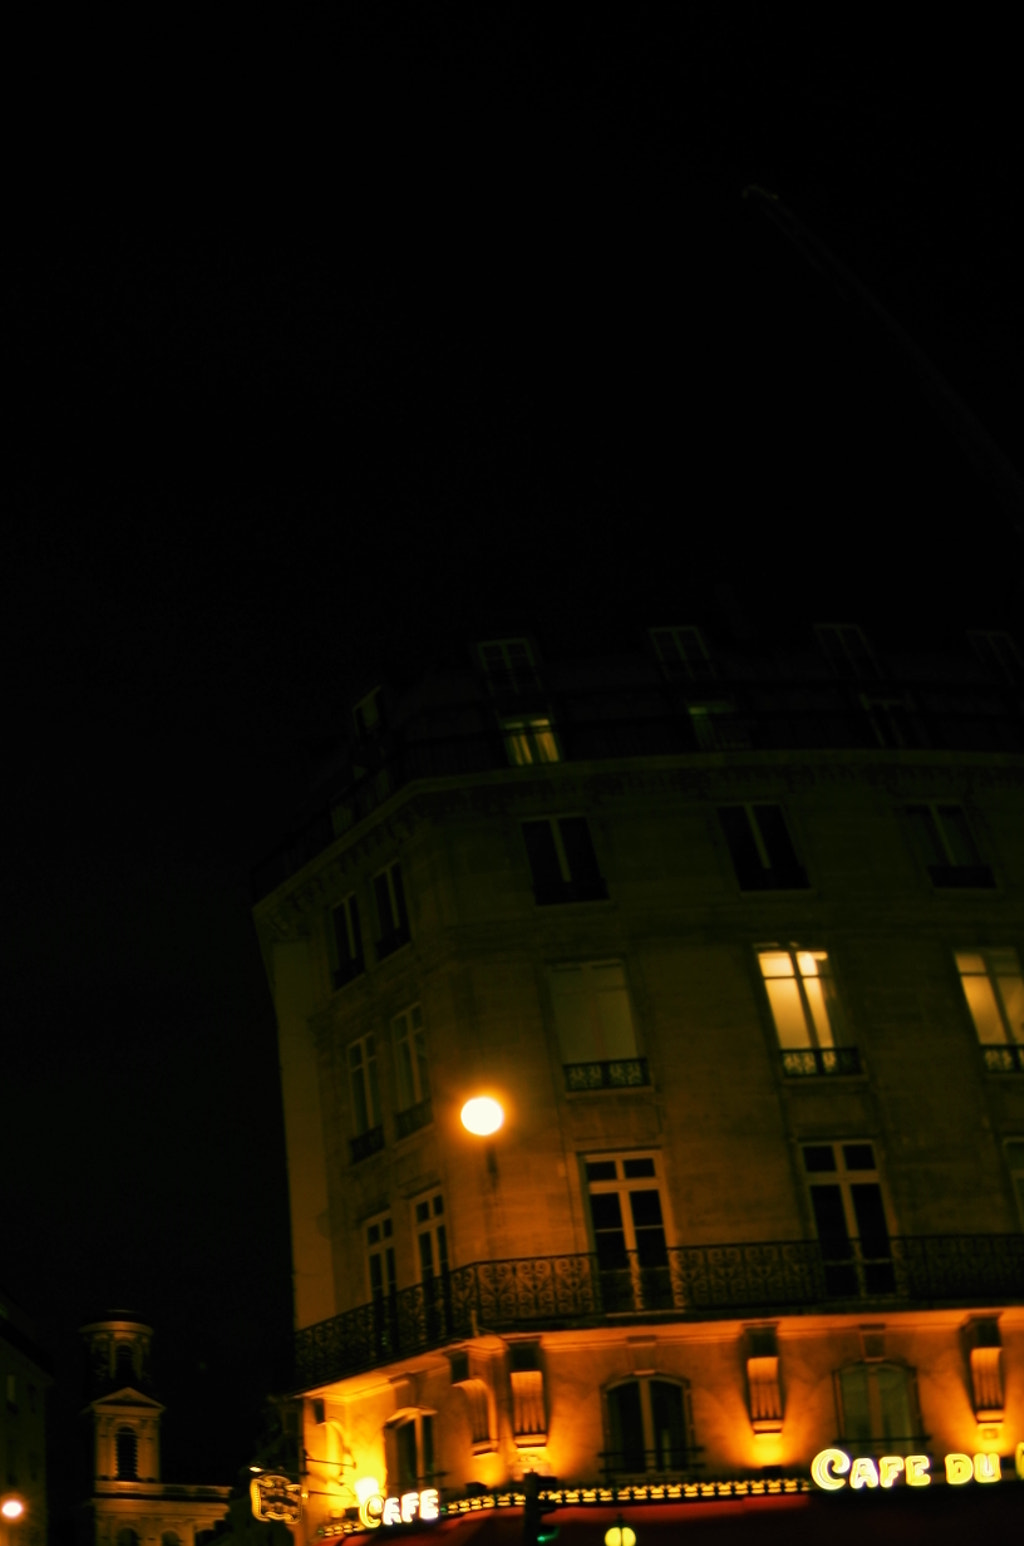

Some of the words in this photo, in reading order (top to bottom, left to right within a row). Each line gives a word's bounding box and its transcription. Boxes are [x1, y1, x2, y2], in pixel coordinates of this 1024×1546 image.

[811, 1449, 931, 1490] CAFE
[944, 1453, 1001, 1485] DU
[359, 1489, 439, 1528] CAFE
